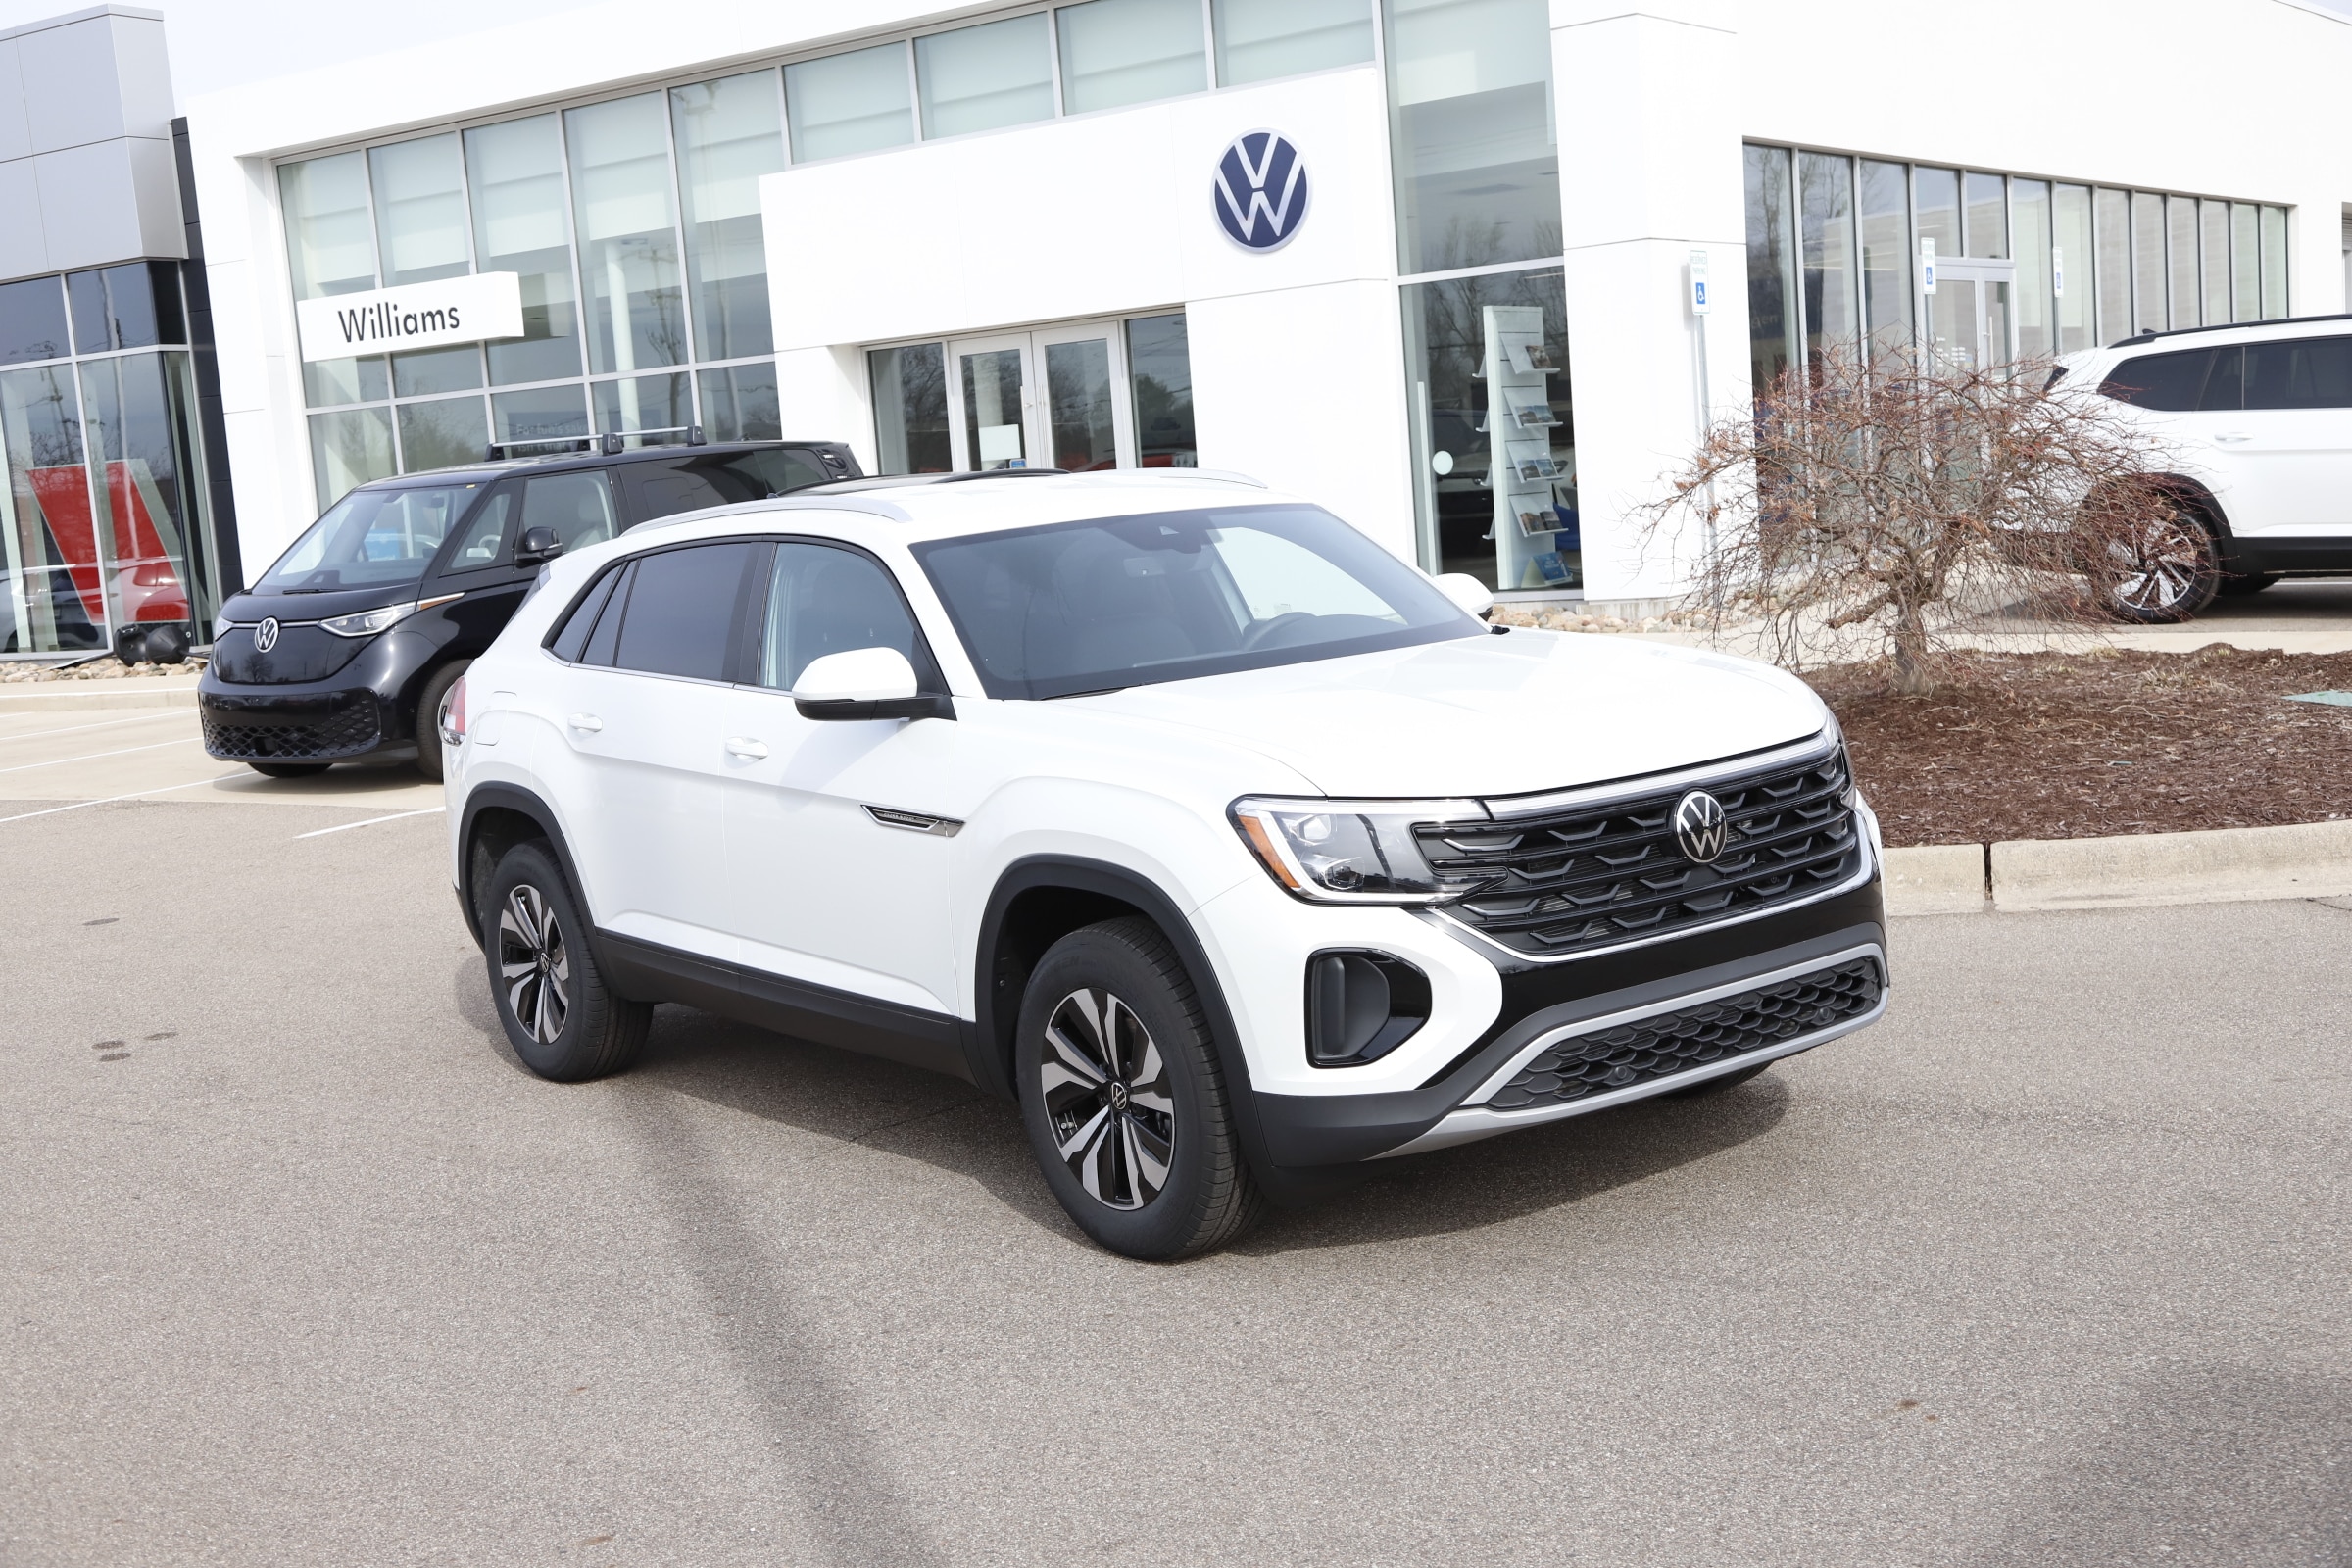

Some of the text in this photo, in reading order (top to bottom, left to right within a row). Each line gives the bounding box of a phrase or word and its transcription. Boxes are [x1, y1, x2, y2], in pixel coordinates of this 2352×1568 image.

[1212, 130, 1309, 249] VW
[338, 302, 460, 343] Williams
[255, 617, 279, 653] VW
[1677, 791, 1727, 862] VW
